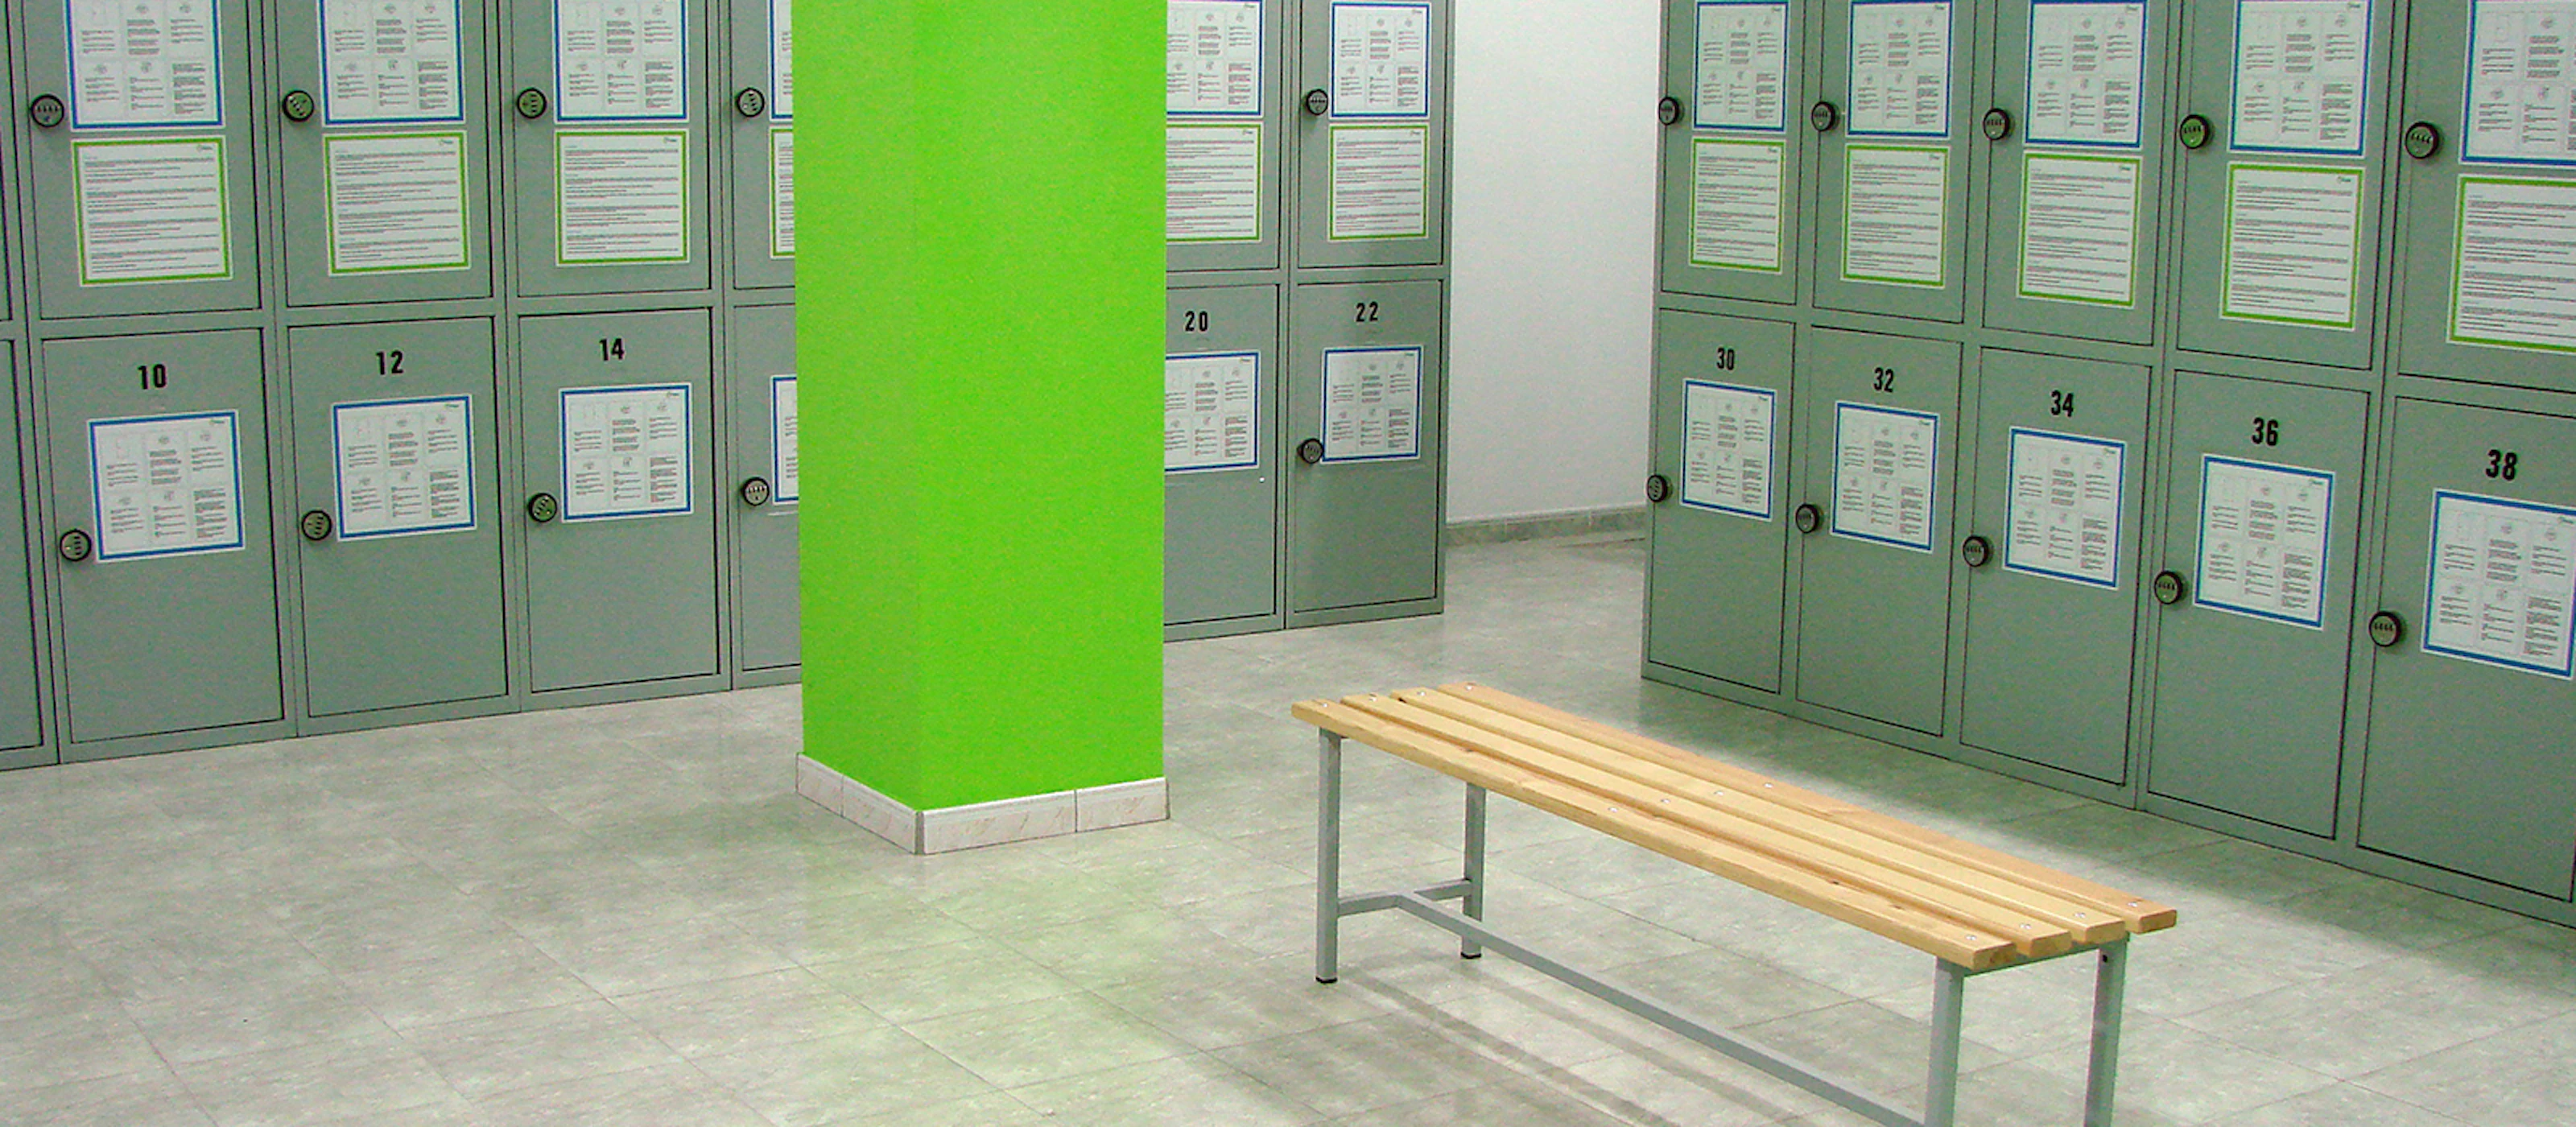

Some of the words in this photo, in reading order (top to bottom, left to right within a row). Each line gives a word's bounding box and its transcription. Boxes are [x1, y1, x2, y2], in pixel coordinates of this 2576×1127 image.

[1185, 311, 1208, 332] 20
[1356, 301, 1379, 323] 22
[375, 349, 404, 376] 12
[599, 337, 625, 361] 14
[1716, 347, 1736, 371] 30
[138, 363, 167, 390] 10
[1873, 366, 1895, 394] 32
[2050, 390, 2074, 418] 34
[2251, 417, 2279, 447] 36
[2485, 449, 2518, 481] 38
